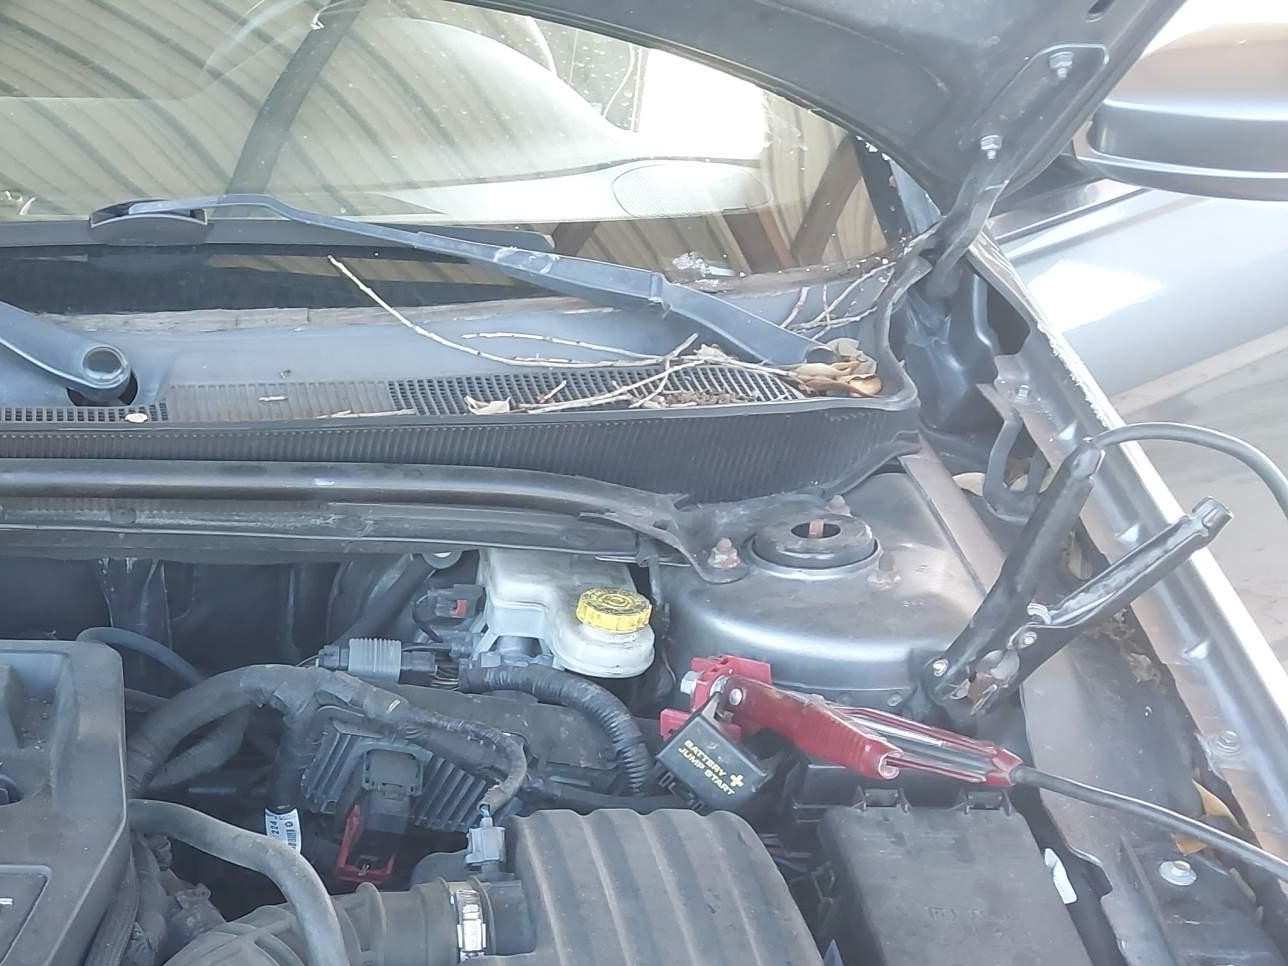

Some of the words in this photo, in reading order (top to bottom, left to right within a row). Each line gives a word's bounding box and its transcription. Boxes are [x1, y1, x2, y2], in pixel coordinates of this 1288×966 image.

[677, 747, 705, 770] JUMP
[704, 769, 735, 795] START
[684, 739, 727, 777] BATTERY
